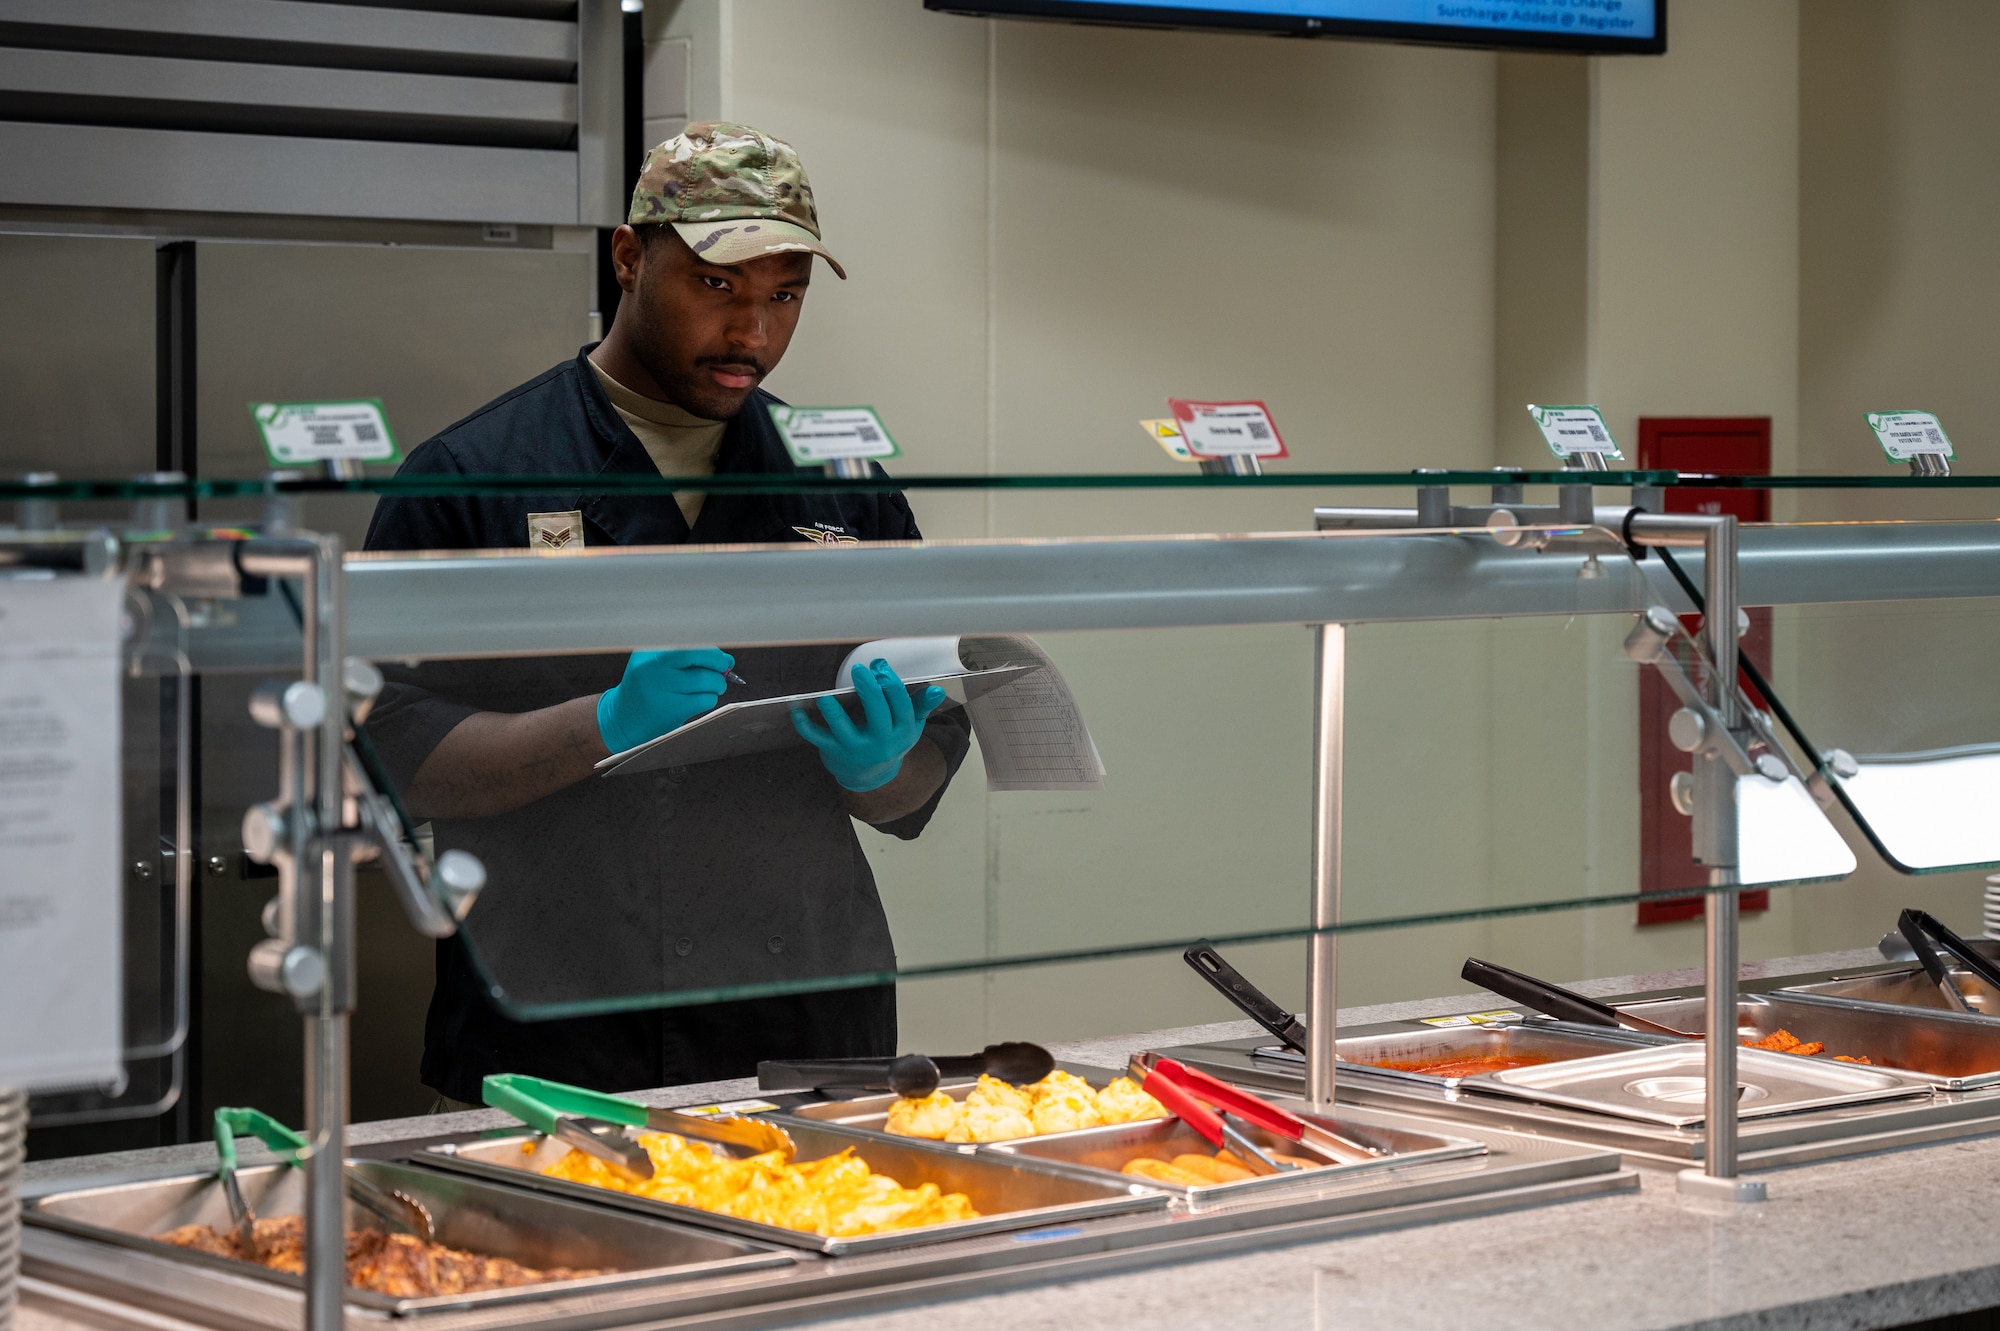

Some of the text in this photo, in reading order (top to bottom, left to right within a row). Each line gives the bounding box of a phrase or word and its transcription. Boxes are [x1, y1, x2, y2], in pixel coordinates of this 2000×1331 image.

[1570, 0, 1623, 12] Change
[1437, 3, 1635, 30] Surcharge Added @ Register
[824, 525, 845, 533] FORCE
